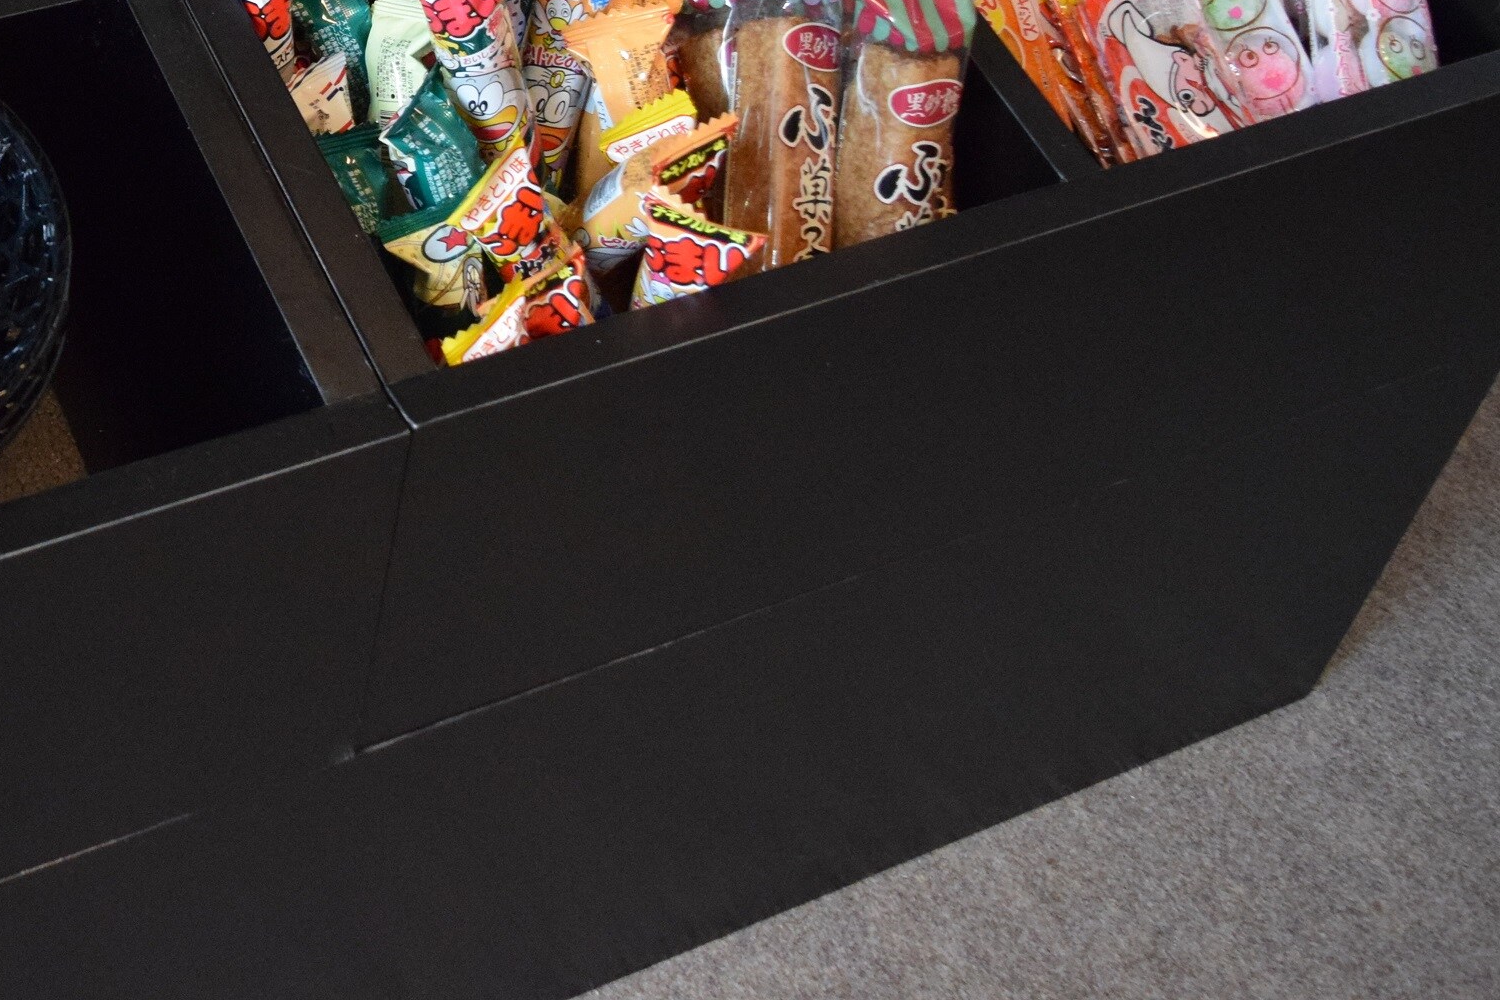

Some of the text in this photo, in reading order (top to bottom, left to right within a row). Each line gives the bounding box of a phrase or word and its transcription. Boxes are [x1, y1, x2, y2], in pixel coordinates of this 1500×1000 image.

[900, 86, 961, 119] 黒砂糖
[613, 121, 691, 156] やきとり味
[465, 155, 529, 223] やきとり味
